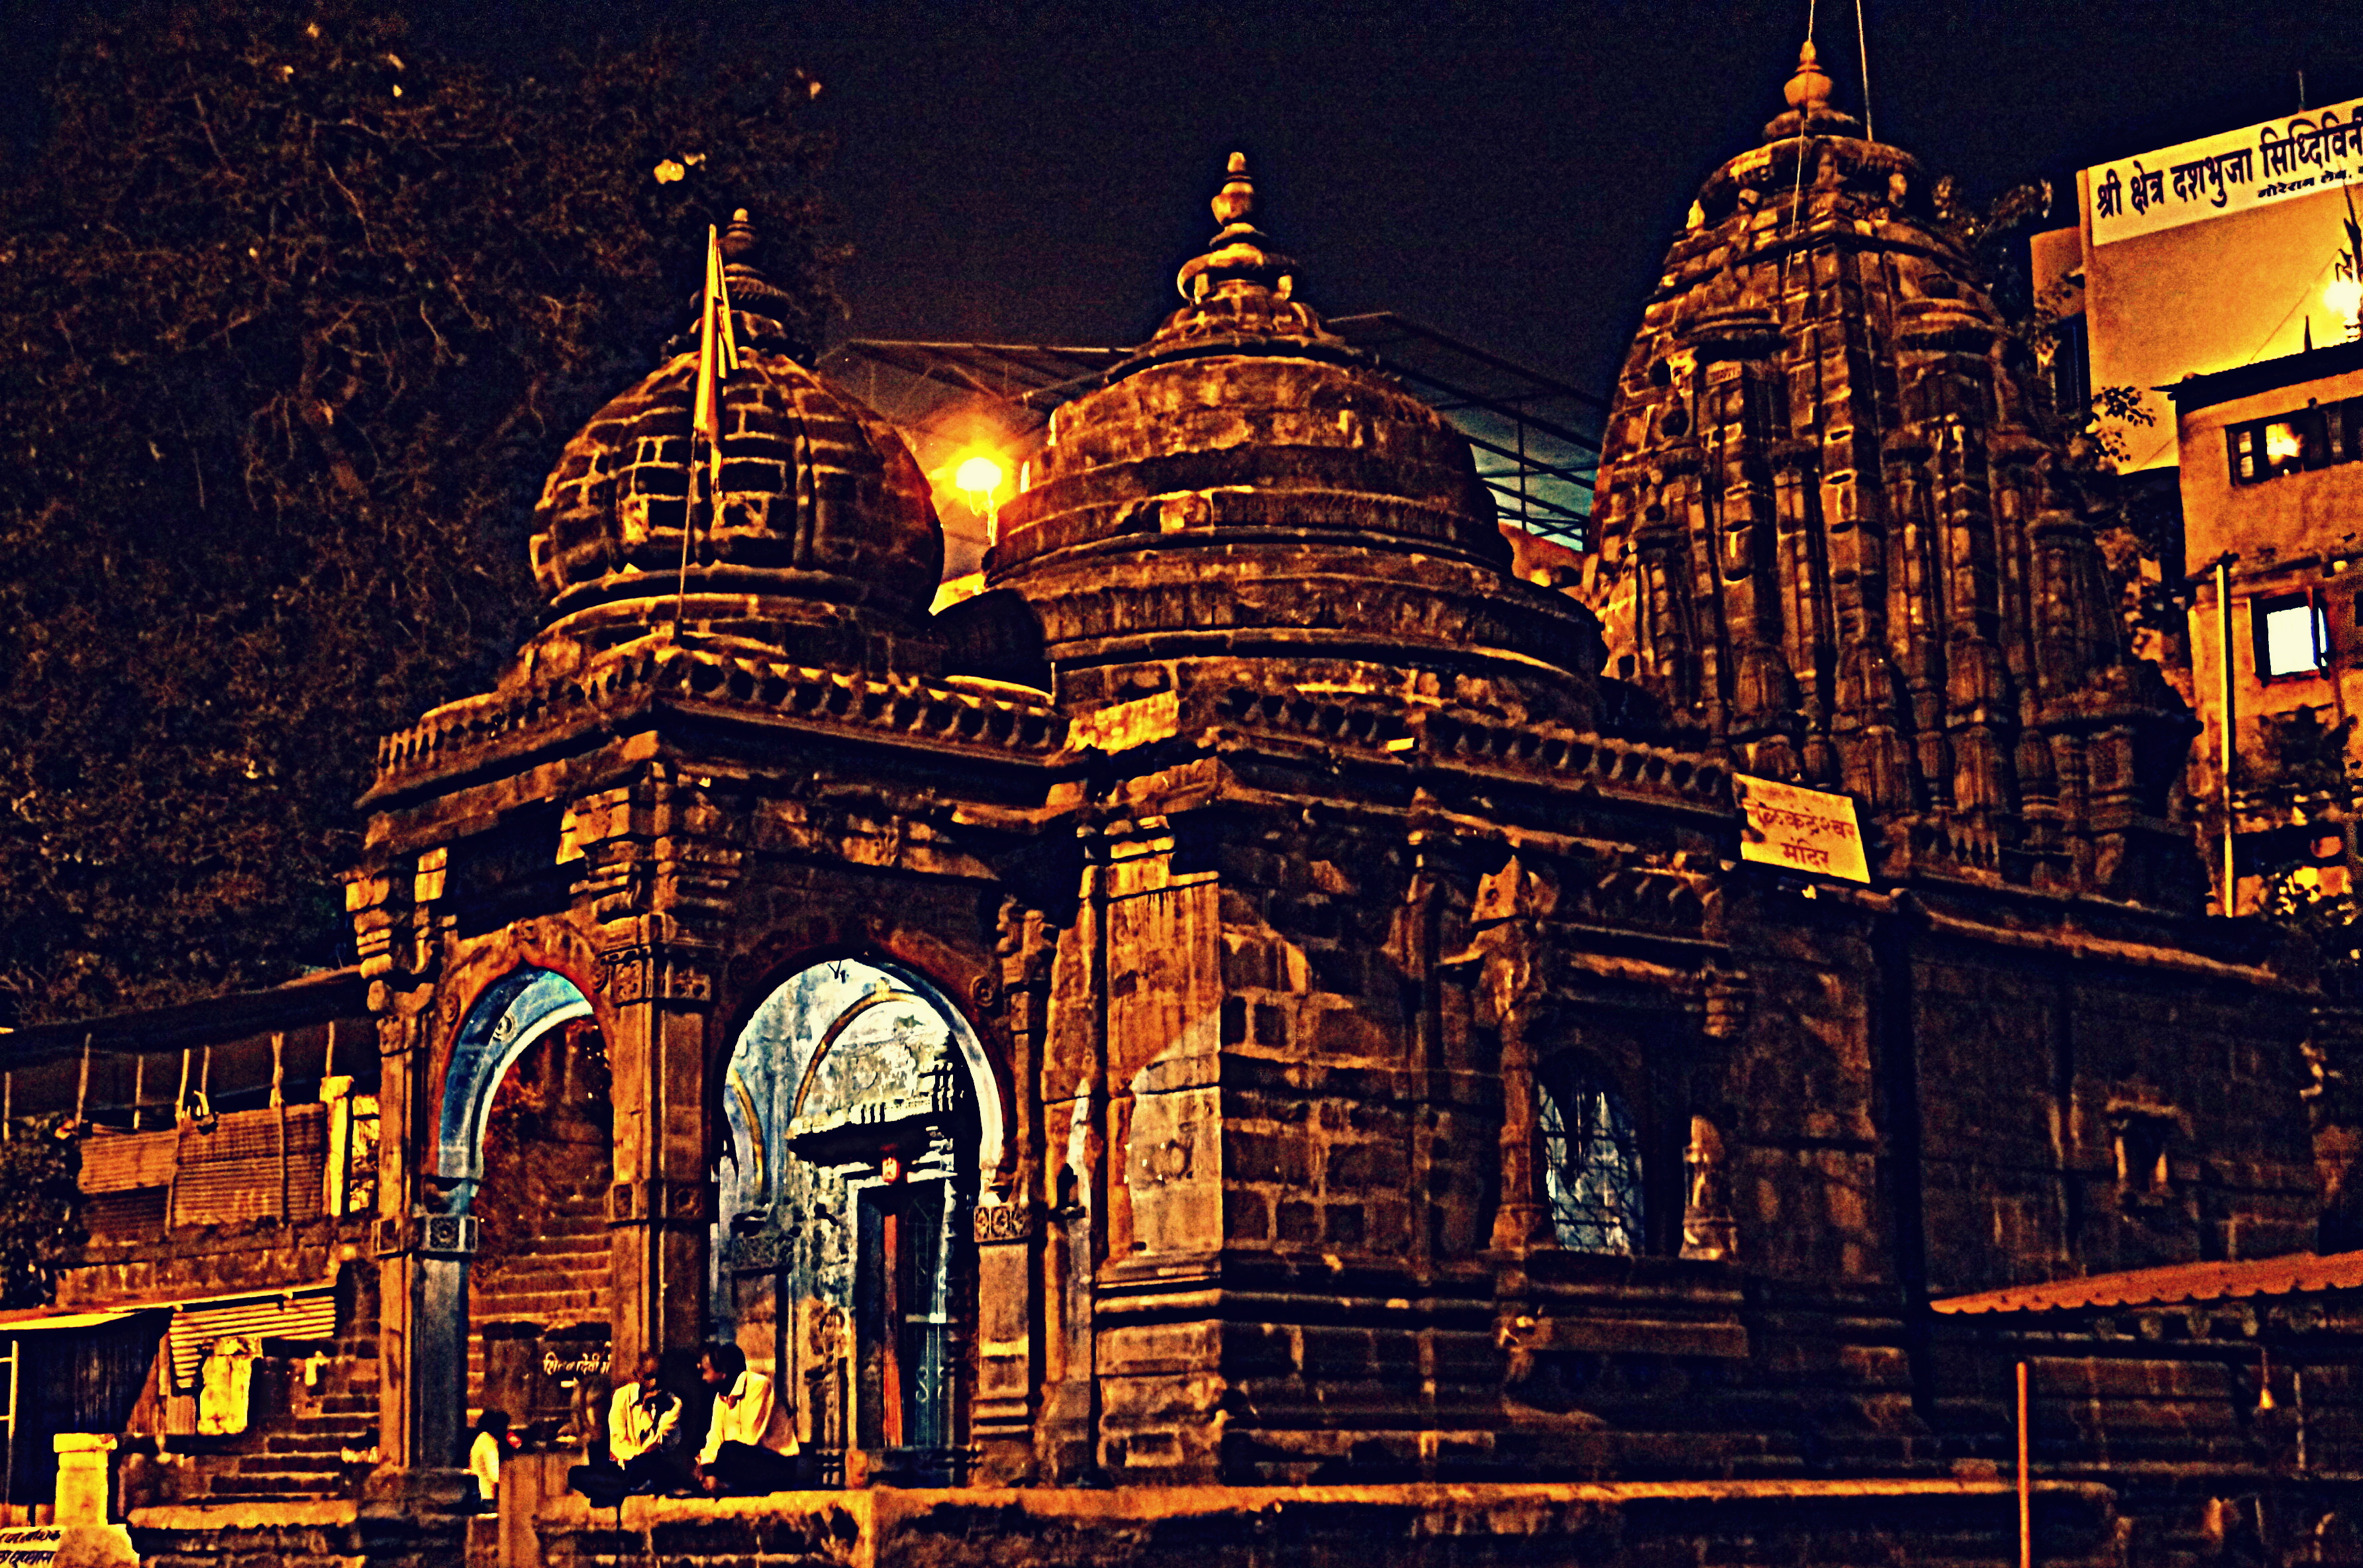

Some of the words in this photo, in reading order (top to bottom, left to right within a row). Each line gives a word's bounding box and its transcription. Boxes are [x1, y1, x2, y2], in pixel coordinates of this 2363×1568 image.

[2097, 168, 2123, 218] श्री
[2130, 160, 2165, 215] क्षेत्र
[2170, 148, 2252, 208] दशभुजा
[1781, 837, 1830, 867] मंदिर
